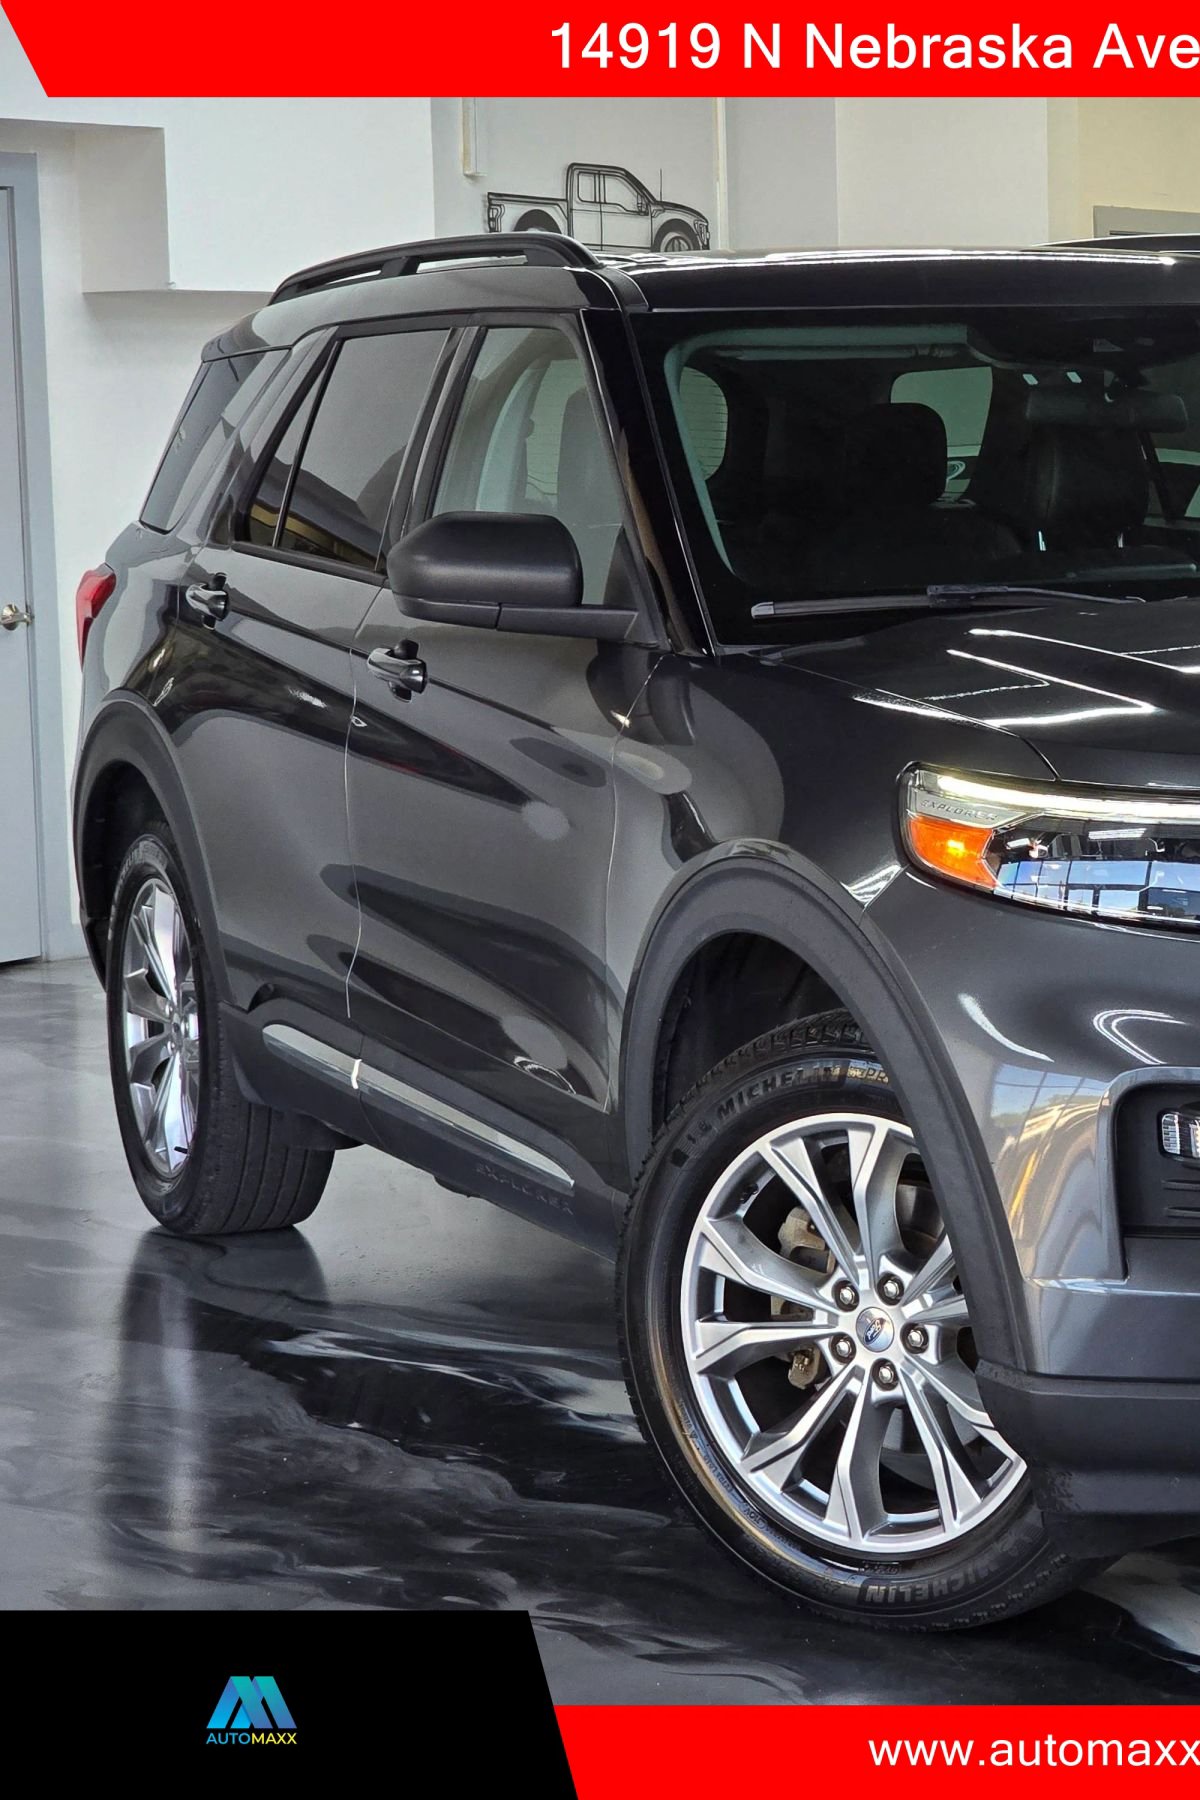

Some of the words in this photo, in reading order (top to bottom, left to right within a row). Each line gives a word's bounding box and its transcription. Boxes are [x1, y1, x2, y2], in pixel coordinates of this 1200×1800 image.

[920, 799, 998, 821] EXPLORER
[718, 1062, 842, 1121] MICHELIN
[865, 1553, 1000, 1603] MICHELIN
